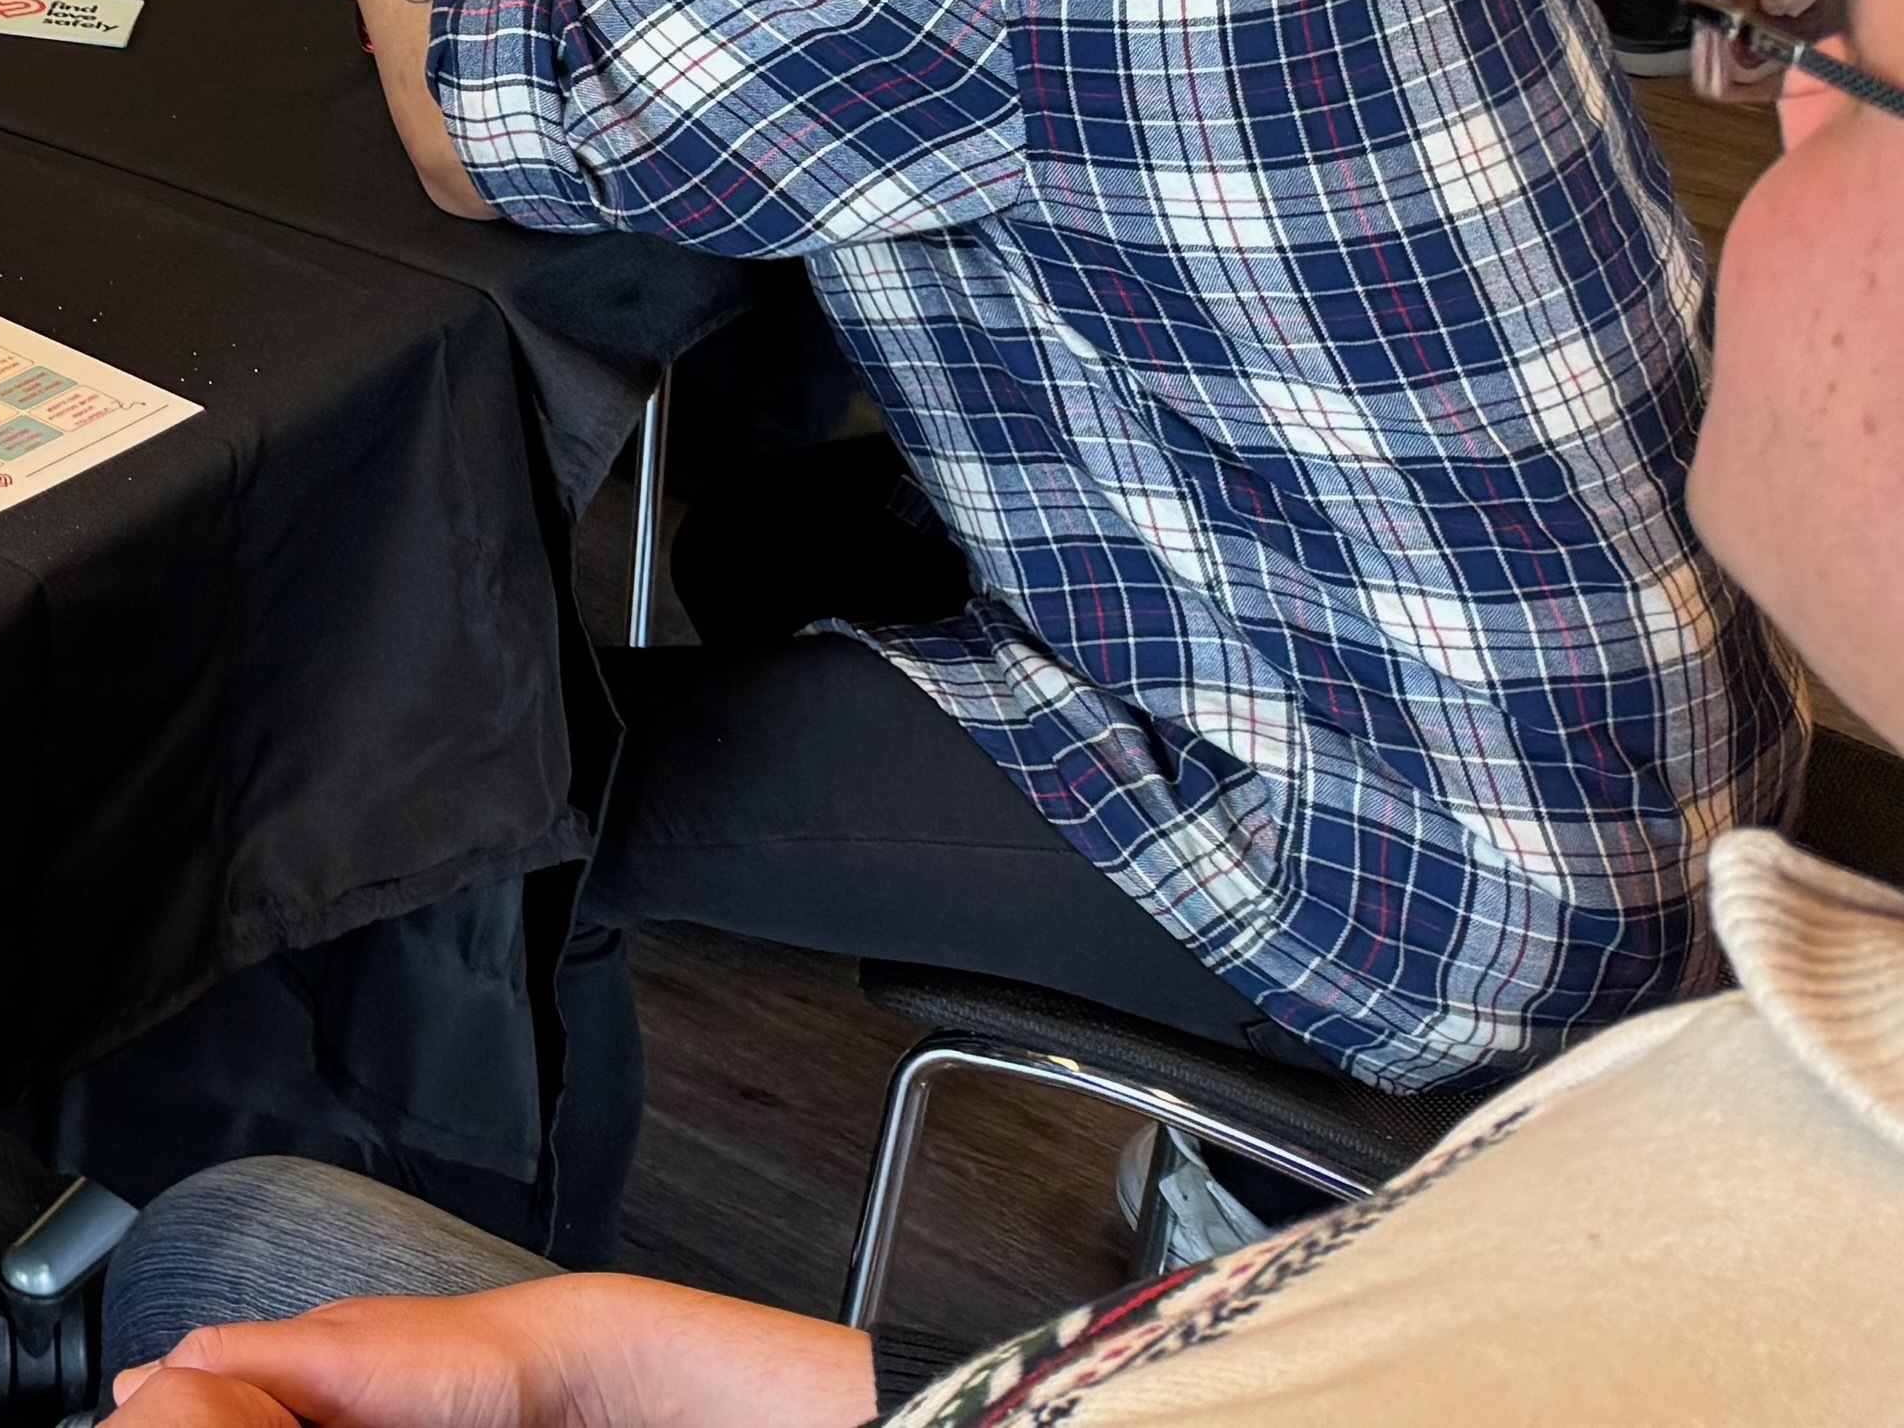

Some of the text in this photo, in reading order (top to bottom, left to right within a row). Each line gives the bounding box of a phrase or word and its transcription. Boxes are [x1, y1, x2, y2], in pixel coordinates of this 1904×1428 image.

[50, 0, 99, 15] find
[47, 9, 98, 23] love
[42, 16, 120, 34] safely
